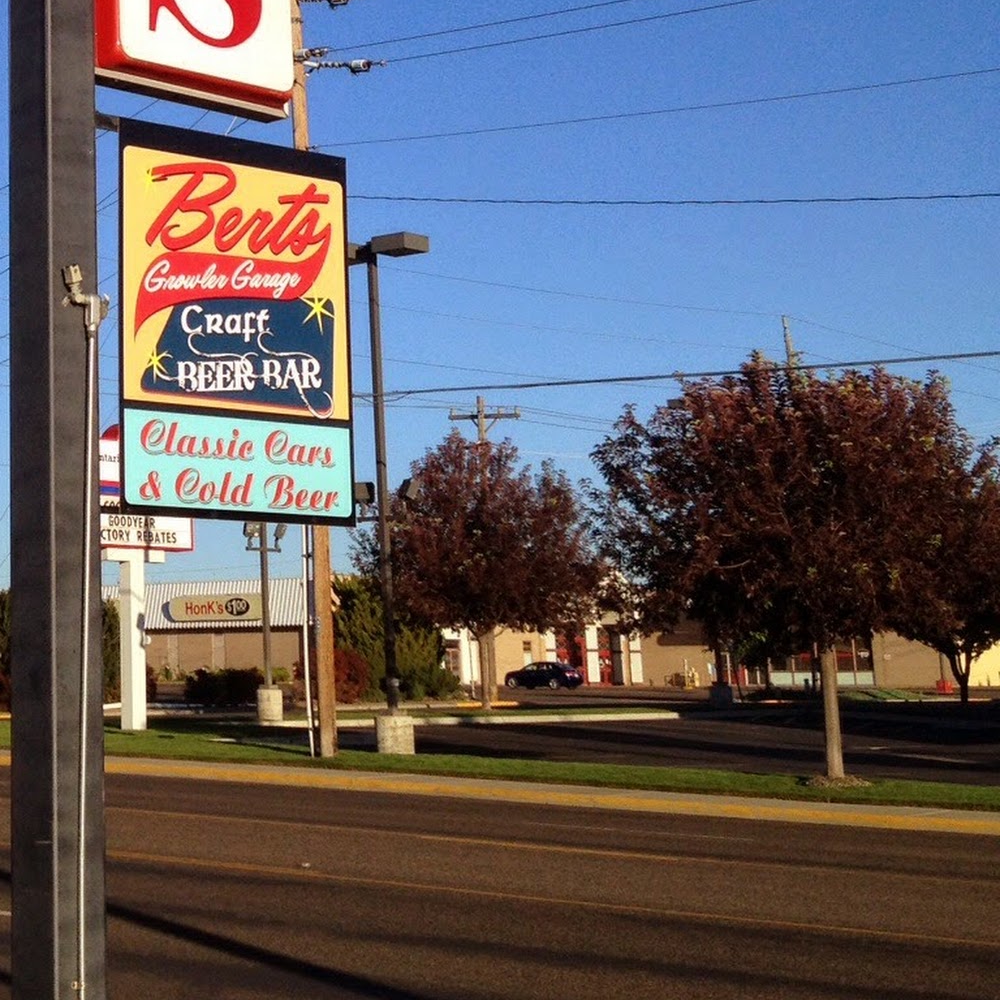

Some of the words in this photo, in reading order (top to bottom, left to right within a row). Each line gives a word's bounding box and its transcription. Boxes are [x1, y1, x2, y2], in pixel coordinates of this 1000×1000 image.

[145, 162, 331, 256] Berts
[144, 259, 229, 293] Growler
[231, 259, 302, 298] Garage
[181, 305, 271, 342] Craft
[177, 359, 256, 393] BEER
[262, 358, 322, 390] BAR
[140, 418, 254, 462] Classic
[265, 430, 336, 468] Cars
[139, 471, 161, 501] &
[175, 468, 255, 507] Cold
[264, 474, 339, 512] Beer
[108, 515, 156, 529] GOODYEAR
[137, 531, 177, 544] REBATES
